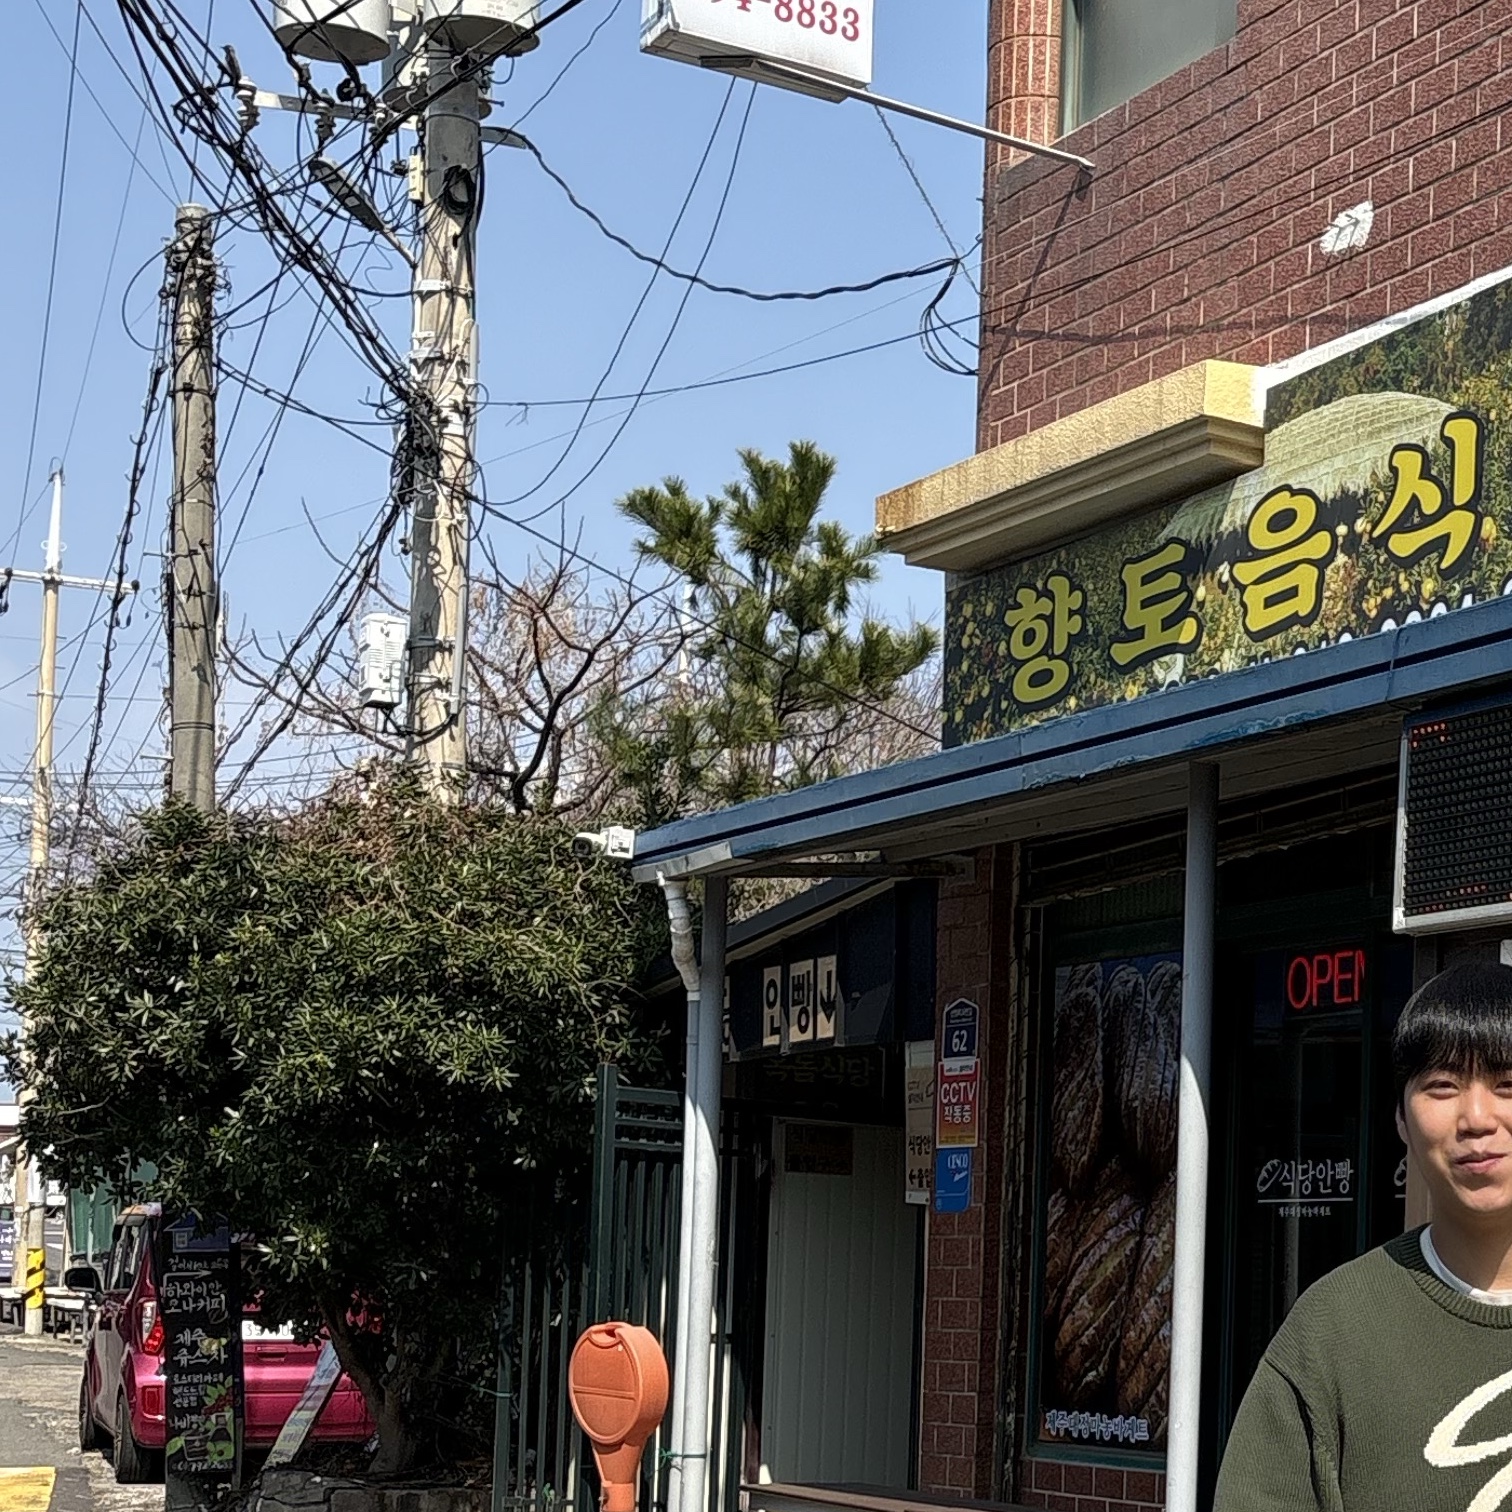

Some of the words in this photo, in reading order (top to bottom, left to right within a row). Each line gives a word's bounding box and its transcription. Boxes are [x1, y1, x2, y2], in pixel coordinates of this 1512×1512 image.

[951, 1029, 968, 1053] 62
[940, 1081, 977, 1105] CCTV
[944, 1104, 972, 1124] 작동중
[1279, 1158, 1354, 1196] 식당안빵
